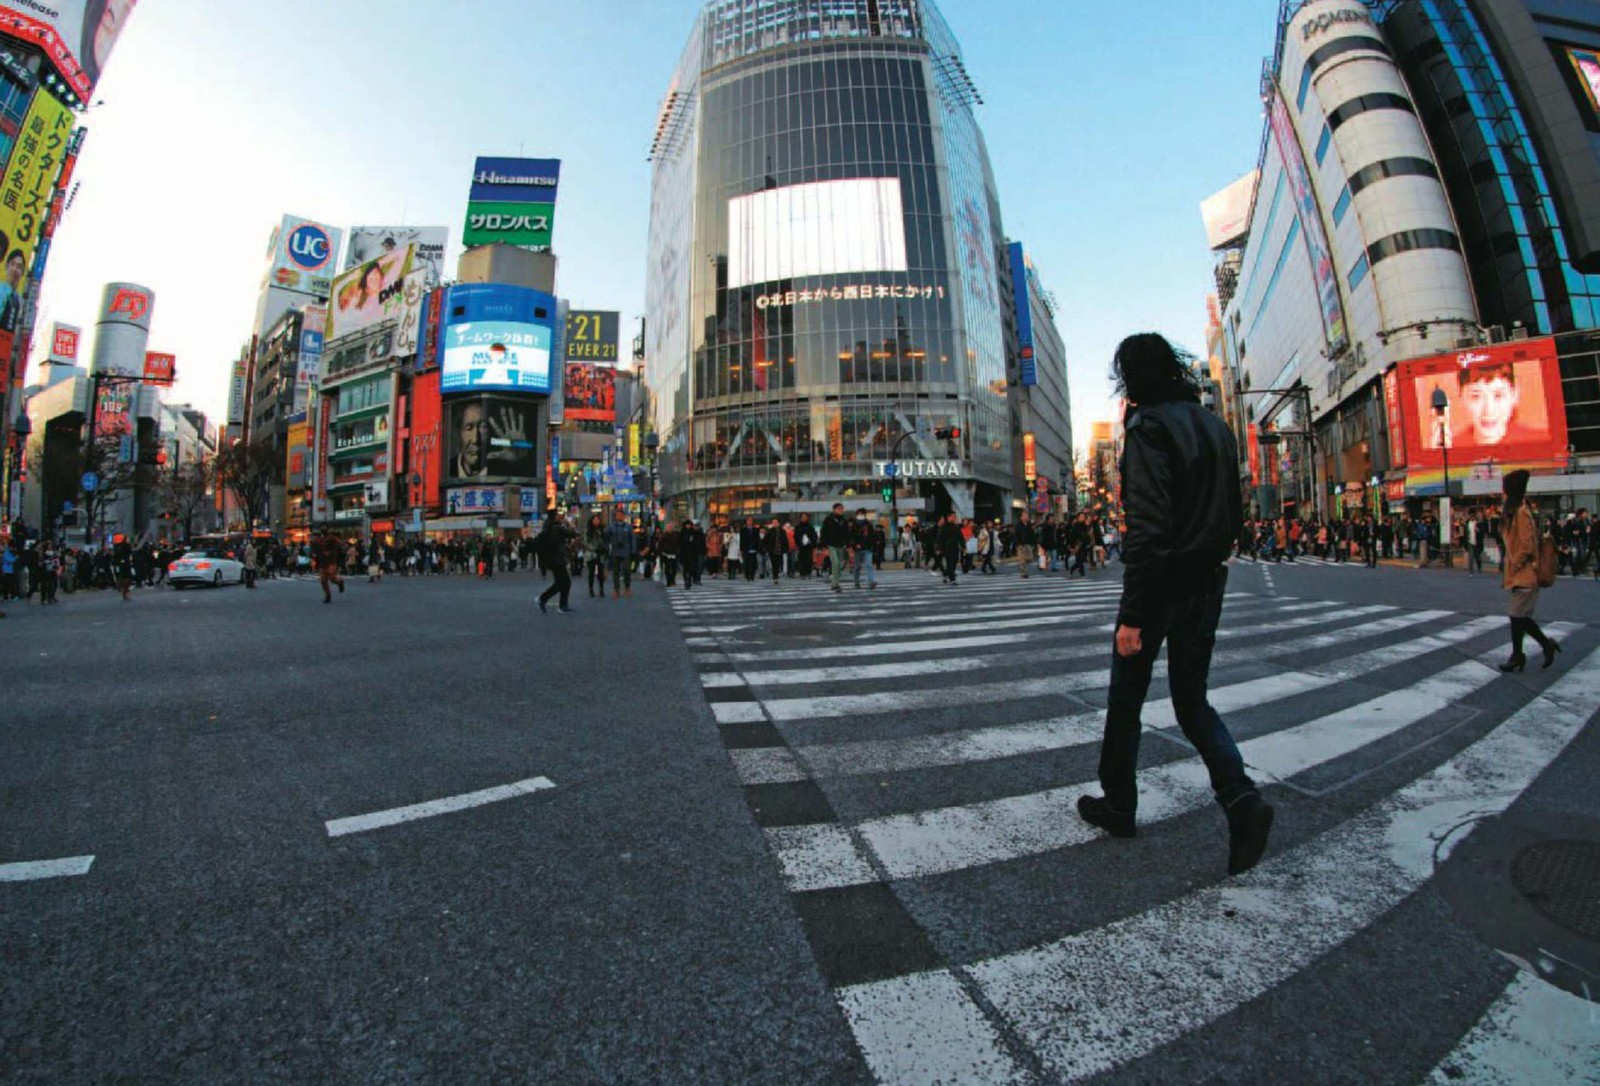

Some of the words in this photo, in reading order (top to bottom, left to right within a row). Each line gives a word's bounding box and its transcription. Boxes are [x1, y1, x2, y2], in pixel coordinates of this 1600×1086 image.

[470, 213, 549, 231] サロンパス
[292, 233, 325, 258] UC
[876, 462, 960, 477] TUTAYA
